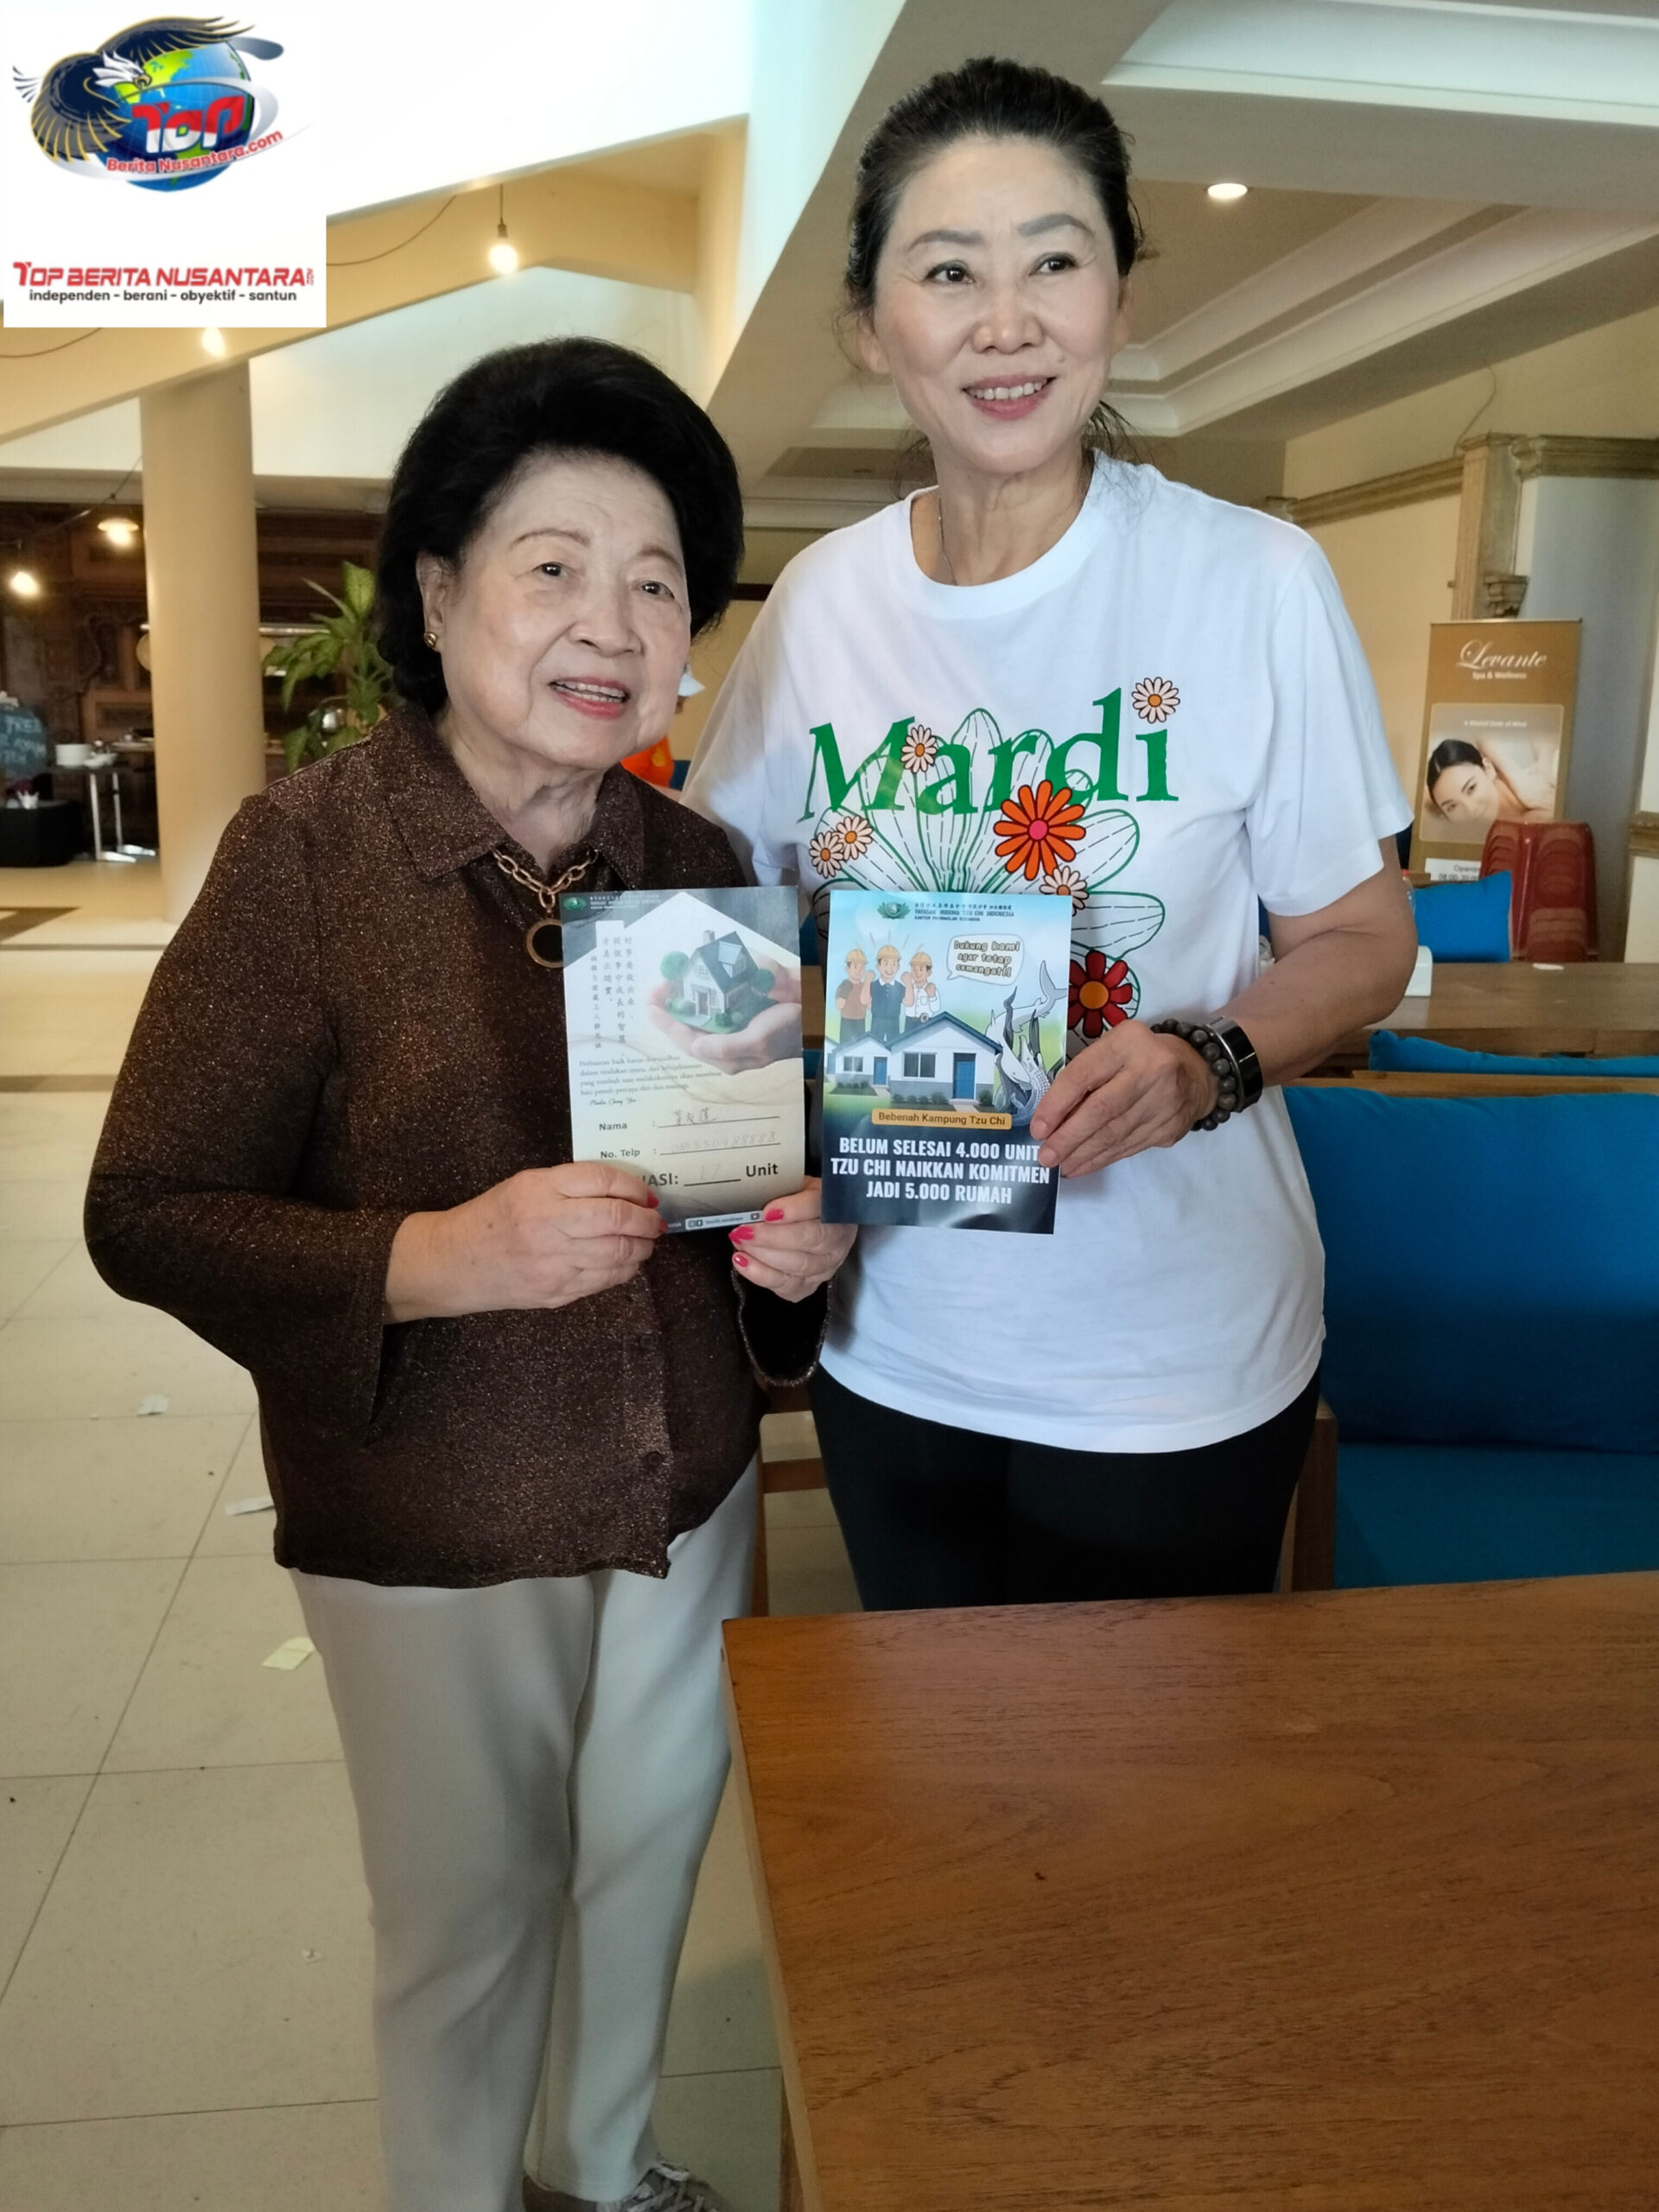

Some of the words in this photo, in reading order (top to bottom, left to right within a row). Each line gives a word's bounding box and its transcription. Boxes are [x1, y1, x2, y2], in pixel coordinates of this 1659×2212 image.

[1456, 639, 1548, 670] Levante
[797, 687, 1179, 823] Mardi
[953, 940, 988, 951] Dukung
[991, 940, 1020, 951] kami
[957, 953, 978, 962] agar
[981, 953, 1012, 966] tetap
[599, 1122, 628, 1131] Nama
[878, 1112, 920, 1122] Bebenah
[921, 1113, 968, 1126] Kampung
[970, 1116, 987, 1125] Tzu
[989, 1116, 1006, 1126] Chi
[600, 1150, 617, 1159] No.
[620, 1148, 641, 1159] Telp
[839, 1137, 889, 1155] BELUM
[893, 1139, 951, 1157] SELESAI
[956, 1142, 1001, 1159] 4.000
[1004, 1144, 1040, 1160] UNIT
[745, 1162, 779, 1178] Unit
[830, 1157, 859, 1175] TZU
[863, 1159, 892, 1177] CHI
[895, 1160, 964, 1179] NAIKKAN
[969, 1163, 1051, 1184] KOMITMEN
[642, 1173, 679, 1188] ASI:
[866, 1180, 900, 1198] JADI
[905, 1182, 950, 1201] 5.000
[954, 1185, 1012, 1205] RUMAH
